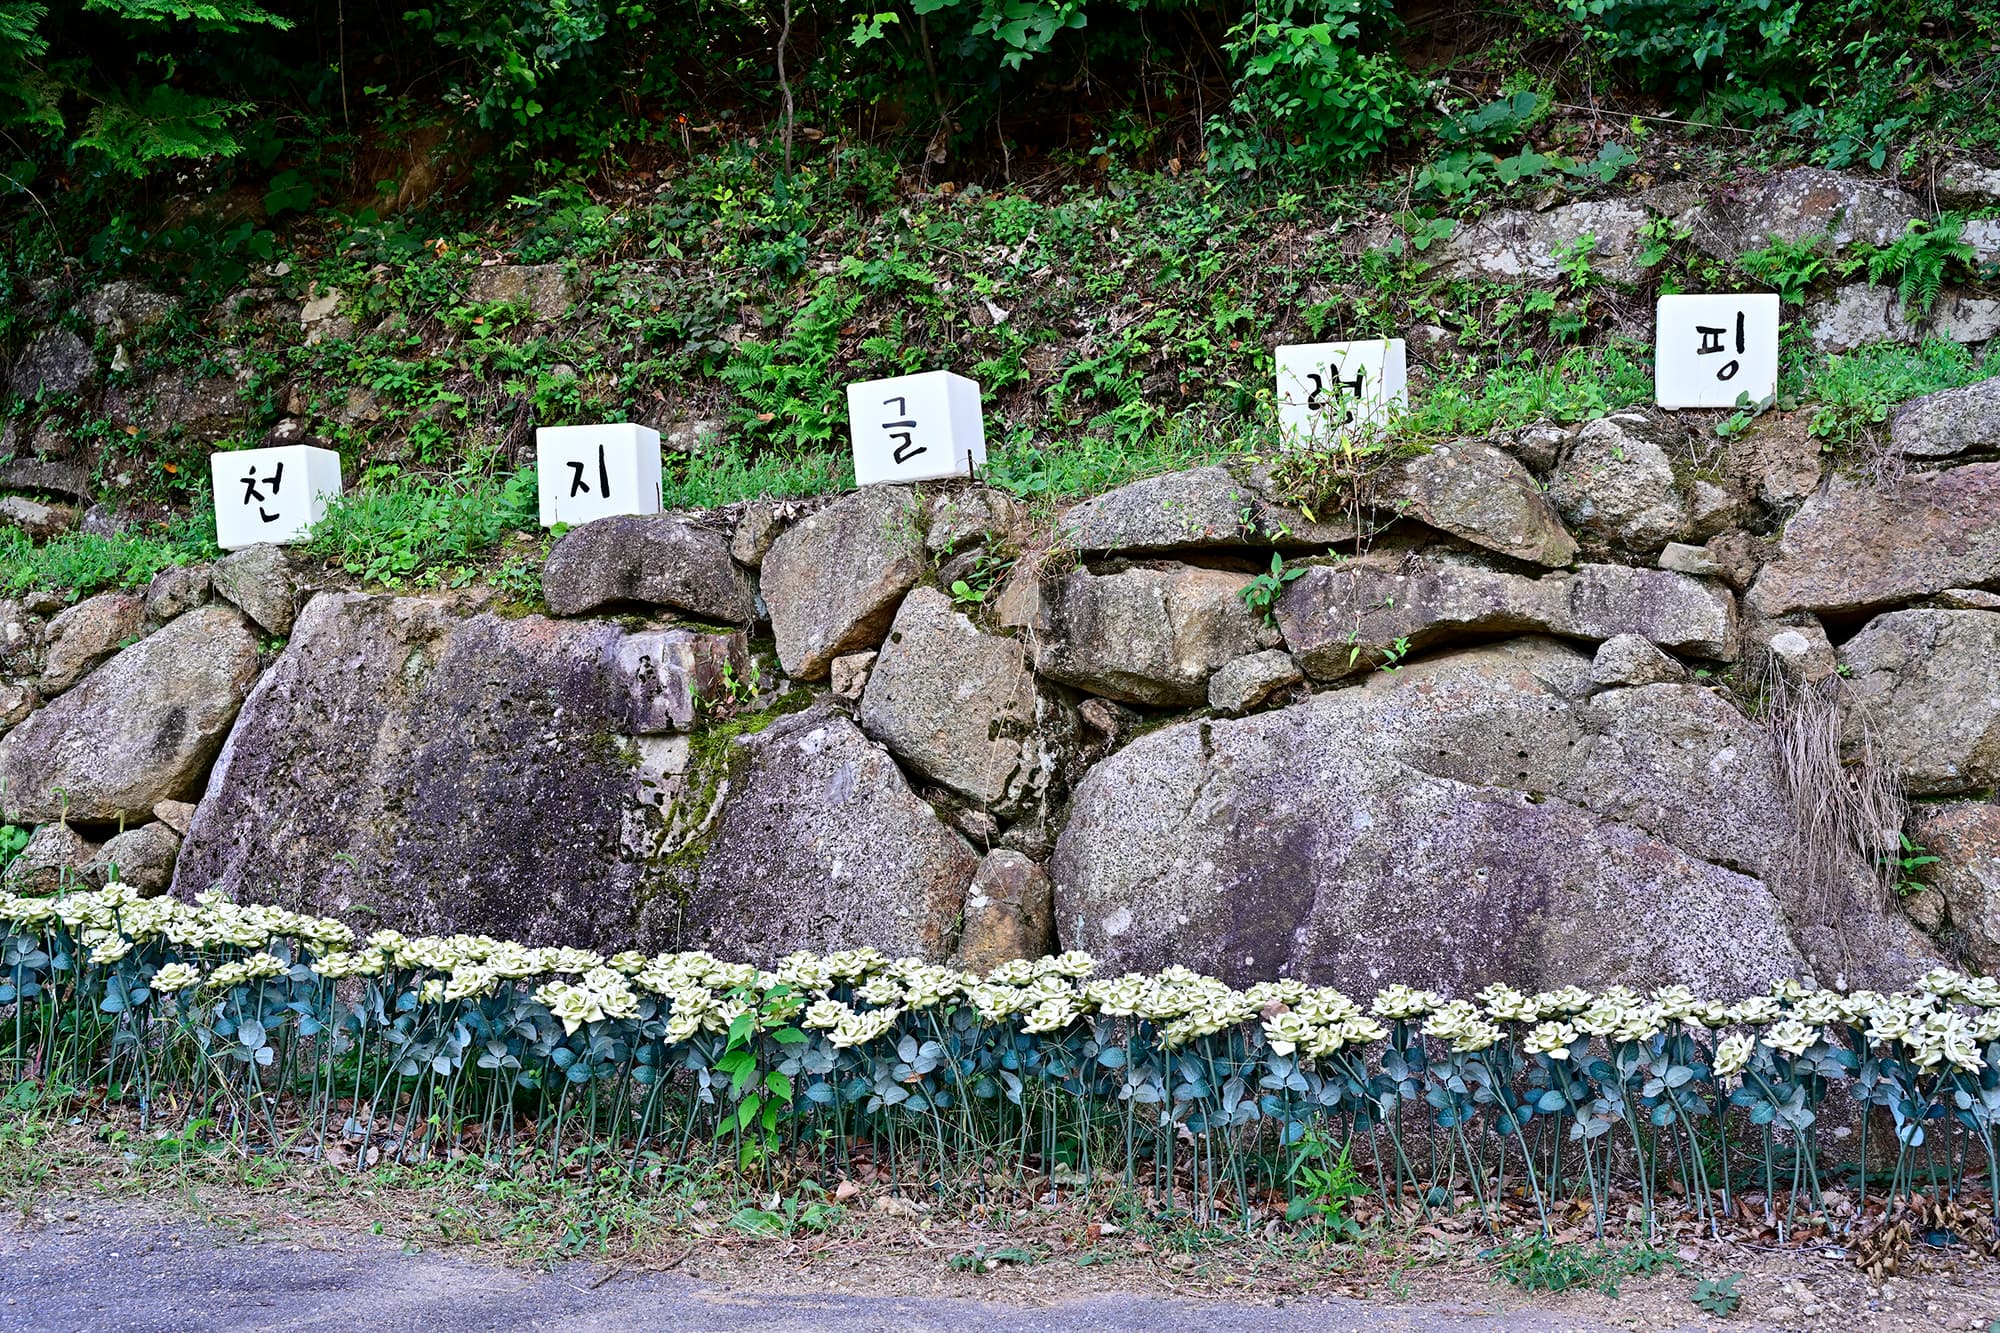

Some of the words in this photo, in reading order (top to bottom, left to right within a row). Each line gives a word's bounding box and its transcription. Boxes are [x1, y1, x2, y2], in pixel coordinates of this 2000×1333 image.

[240, 462, 283, 523] 천
[567, 444, 610, 499] 지
[882, 397, 928, 465] 글
[1696, 311, 1745, 381] 핑
